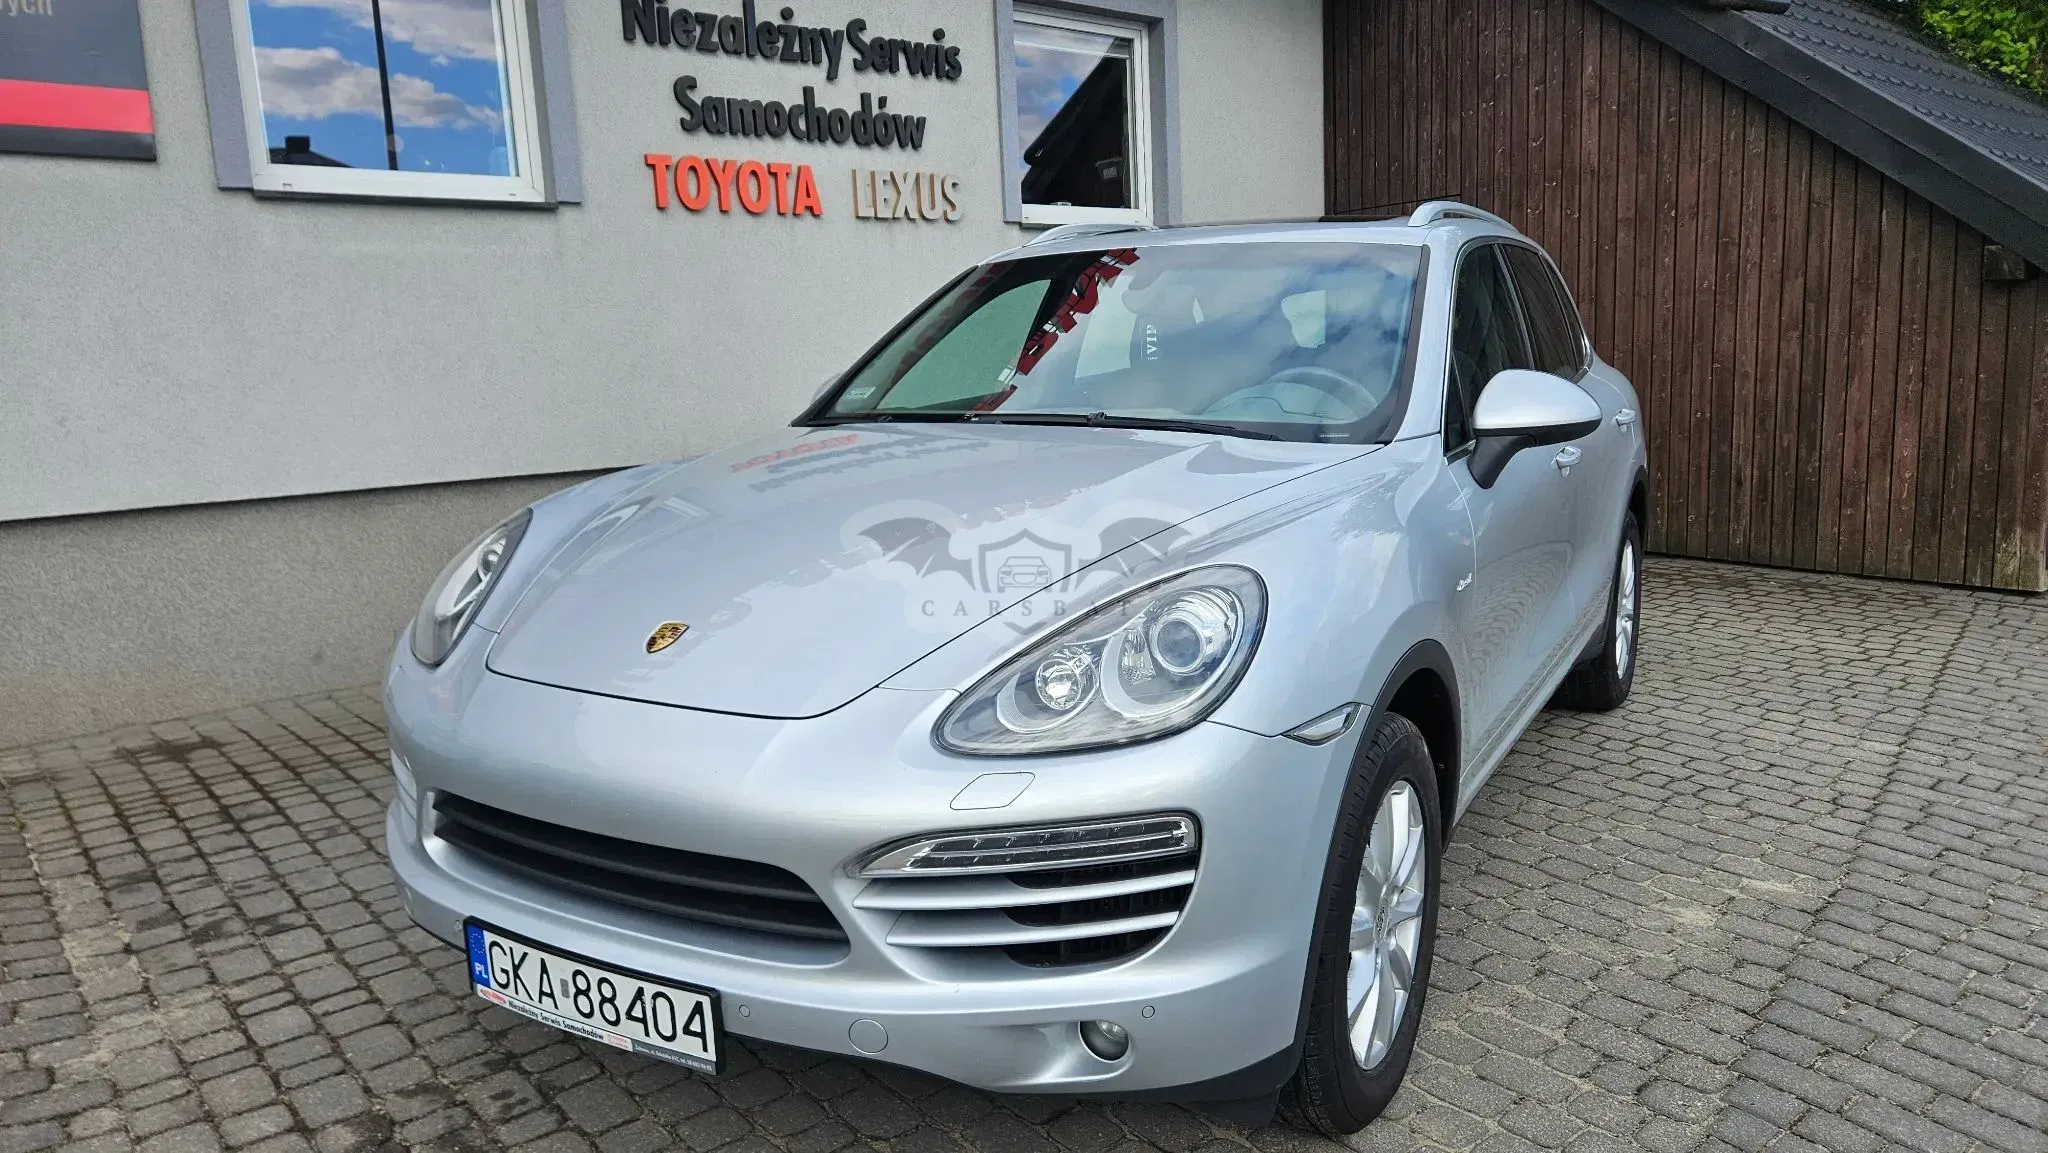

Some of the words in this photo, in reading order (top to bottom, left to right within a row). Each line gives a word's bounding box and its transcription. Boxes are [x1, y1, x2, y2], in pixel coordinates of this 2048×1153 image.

[619, 0, 845, 80] Niezależny
[846, 17, 963, 80] Serwis
[673, 75, 927, 150] Samochodów
[644, 153, 823, 216] TOYOTA
[852, 168, 965, 221] LEXUS
[474, 963, 488, 979] PL
[488, 940, 560, 1010] GKA
[571, 969, 709, 1053] 88404
